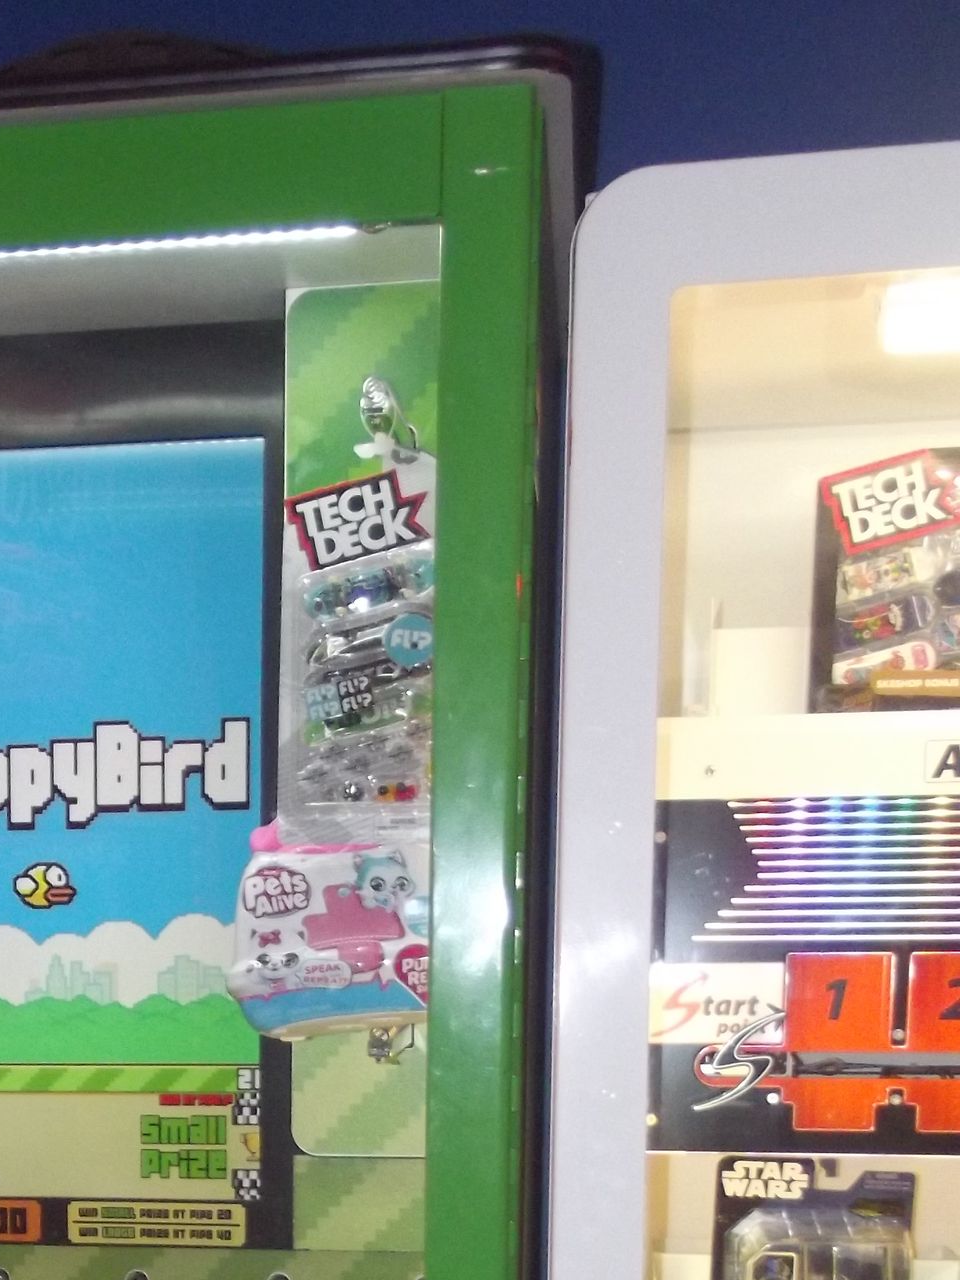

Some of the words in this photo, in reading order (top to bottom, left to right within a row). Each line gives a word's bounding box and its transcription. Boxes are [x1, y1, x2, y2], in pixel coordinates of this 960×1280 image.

[295, 479, 395, 537] TECH
[832, 459, 926, 517] TECH
[312, 506, 417, 565] DECK
[847, 487, 947, 543] DECK
[931, 743, 960, 779] A
[244, 867, 310, 911] Pets
[651, 971, 760, 1037] Start
[825, 979, 849, 1020] 1
[721, 1160, 809, 1181] STAR
[721, 1178, 809, 1200] WARS
[139, 1208, 170, 1219] PRIZE
[172, 1208, 186, 1219] AT
[190, 1208, 213, 1220] PIPE
[139, 1228, 170, 1239] PRIZE
[172, 1228, 186, 1239] AT
[190, 1229, 213, 1240] PIPE
[216, 1229, 232, 1241] 40
